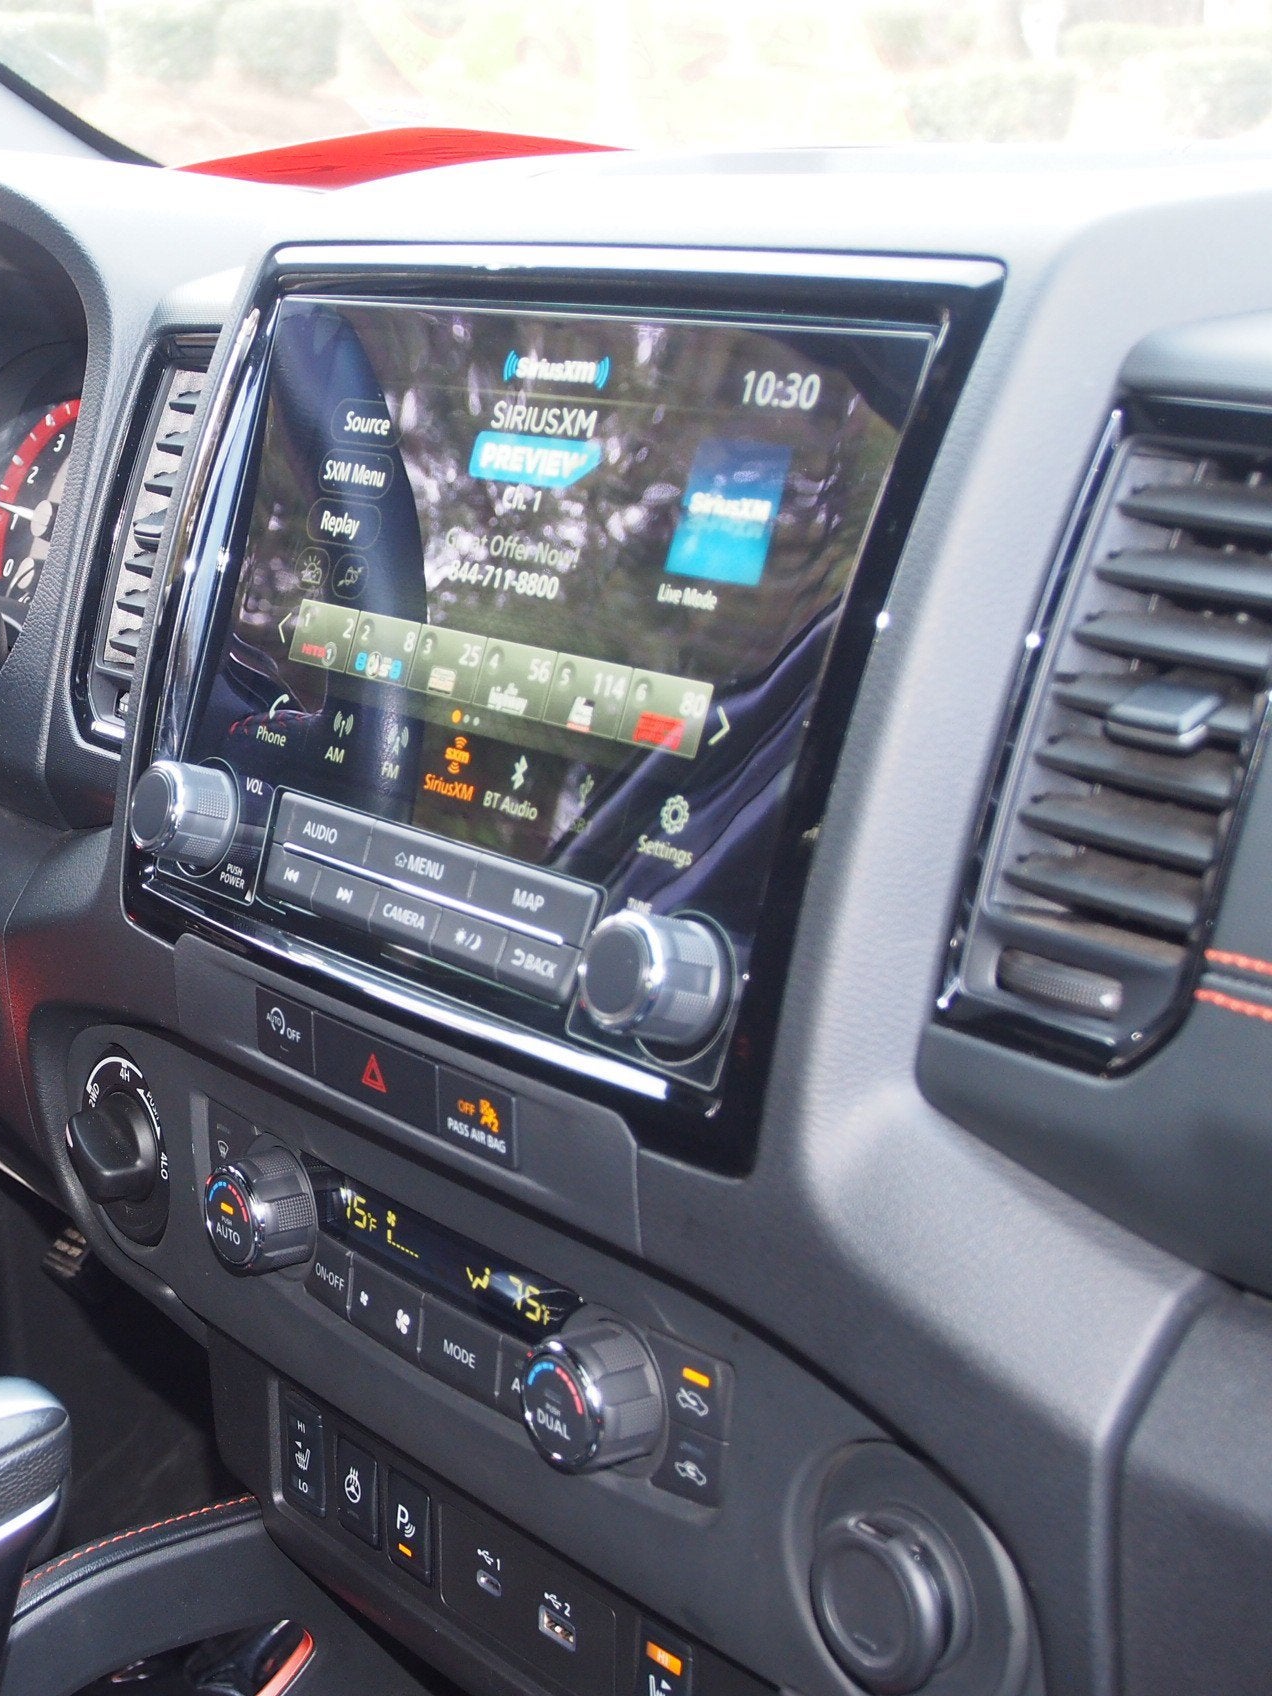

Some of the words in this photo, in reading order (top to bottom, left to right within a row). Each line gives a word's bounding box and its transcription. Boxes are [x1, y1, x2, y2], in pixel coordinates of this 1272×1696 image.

[742, 370, 821, 410] 10:30
[344, 410, 391, 437] Source
[490, 400, 598, 439] SIRIUSXM
[53, 433, 66, 453] 3
[479, 441, 588, 479] PREVIEW
[27, 466, 39, 485] 2
[323, 459, 352, 482] SXM
[351, 463, 386, 488] Menu
[532, 490, 542, 513] 1
[10, 513, 19, 530] 1
[320, 510, 360, 541] Replay
[490, 535, 531, 562] Offer
[2, 558, 14, 578] 0
[446, 559, 560, 600] 844-711-8800
[657, 583, 682, 606] Live
[682, 587, 718, 612] Mode
[304, 612, 312, 628] 1
[342, 618, 355, 639] 2
[360, 624, 372, 641] 2
[403, 631, 418, 653] 8
[421, 638, 433, 655] 3
[458, 643, 485, 668] 25
[489, 652, 500, 669] 4
[527, 657, 553, 685] 56
[559, 668, 572, 687] 5
[593, 671, 626, 701] 114
[635, 682, 648, 701] 6
[256, 725, 287, 747] Phone
[324, 745, 345, 764] AM
[381, 761, 401, 780] FM
[246, 776, 264, 796] VOL
[423, 773, 475, 802] SiriusXM
[483, 791, 501, 810] BT
[500, 797, 539, 821] Audio
[302, 820, 339, 845] AUDIO
[636, 834, 694, 869] Settings
[226, 862, 244, 877] PUSH
[407, 853, 446, 881] MENU
[219, 871, 246, 890] POWER
[511, 888, 546, 912] MAP
[382, 902, 426, 931] CAMERA
[526, 956, 559, 980] BACK
[286, 1027, 302, 1043] OFF
[119, 1067, 130, 1082] 4H
[457, 1099, 476, 1116] OFF
[447, 1115, 470, 1138] PASS
[470, 1127, 487, 1146] AIR
[486, 1134, 507, 1154] BAG
[160, 1151, 169, 1180] 4LO
[216, 1221, 241, 1246] AUTO
[443, 1338, 476, 1370] MODE
[296, 1420, 306, 1434] HI
[536, 1407, 572, 1442] DUAL
[298, 1478, 309, 1494] LO
[396, 1503, 409, 1530] P
